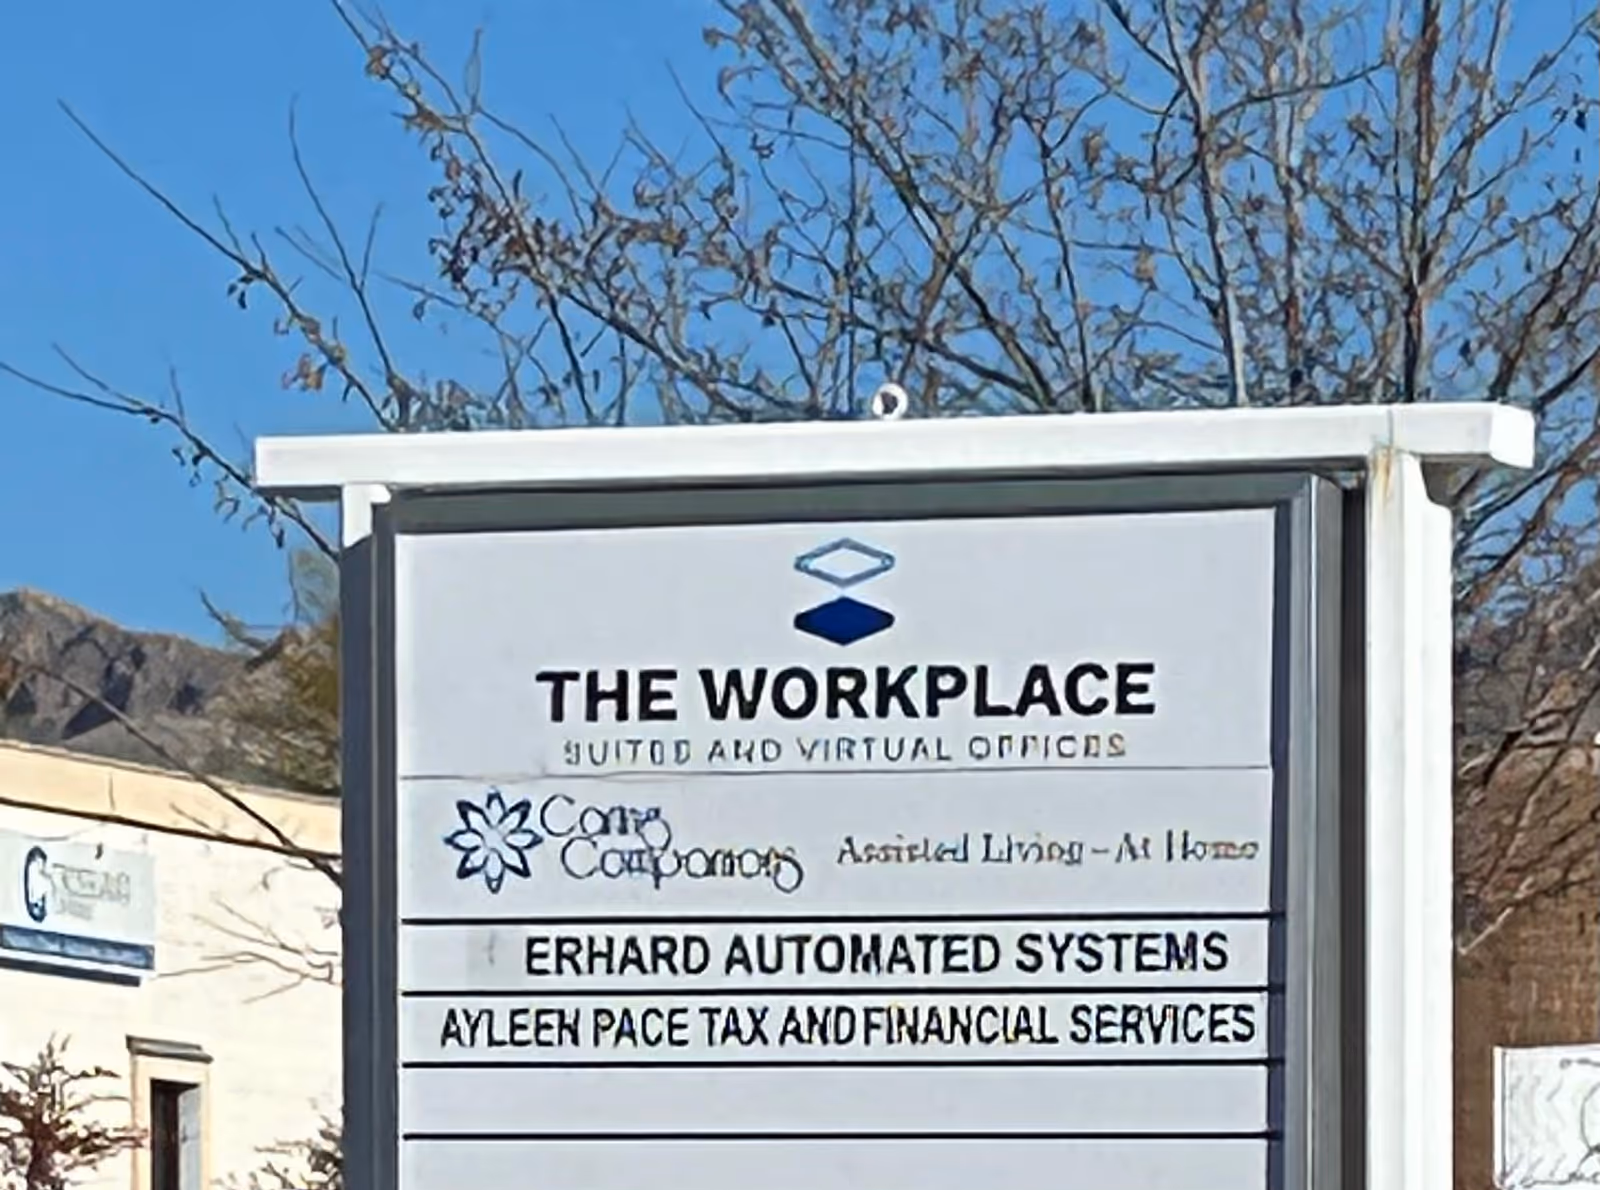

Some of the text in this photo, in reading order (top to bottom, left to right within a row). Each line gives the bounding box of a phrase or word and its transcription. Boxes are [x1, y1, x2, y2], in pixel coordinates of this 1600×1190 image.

[536, 662, 1156, 723] THE WORKPLACE
[796, 736, 953, 763] VIRTUAL
[526, 931, 1229, 977] ERHARD AUTOMATED SYSTEMS
[440, 1003, 1256, 1048] AYLEEN PACE TAX AND FINANCIAL SERVICES
